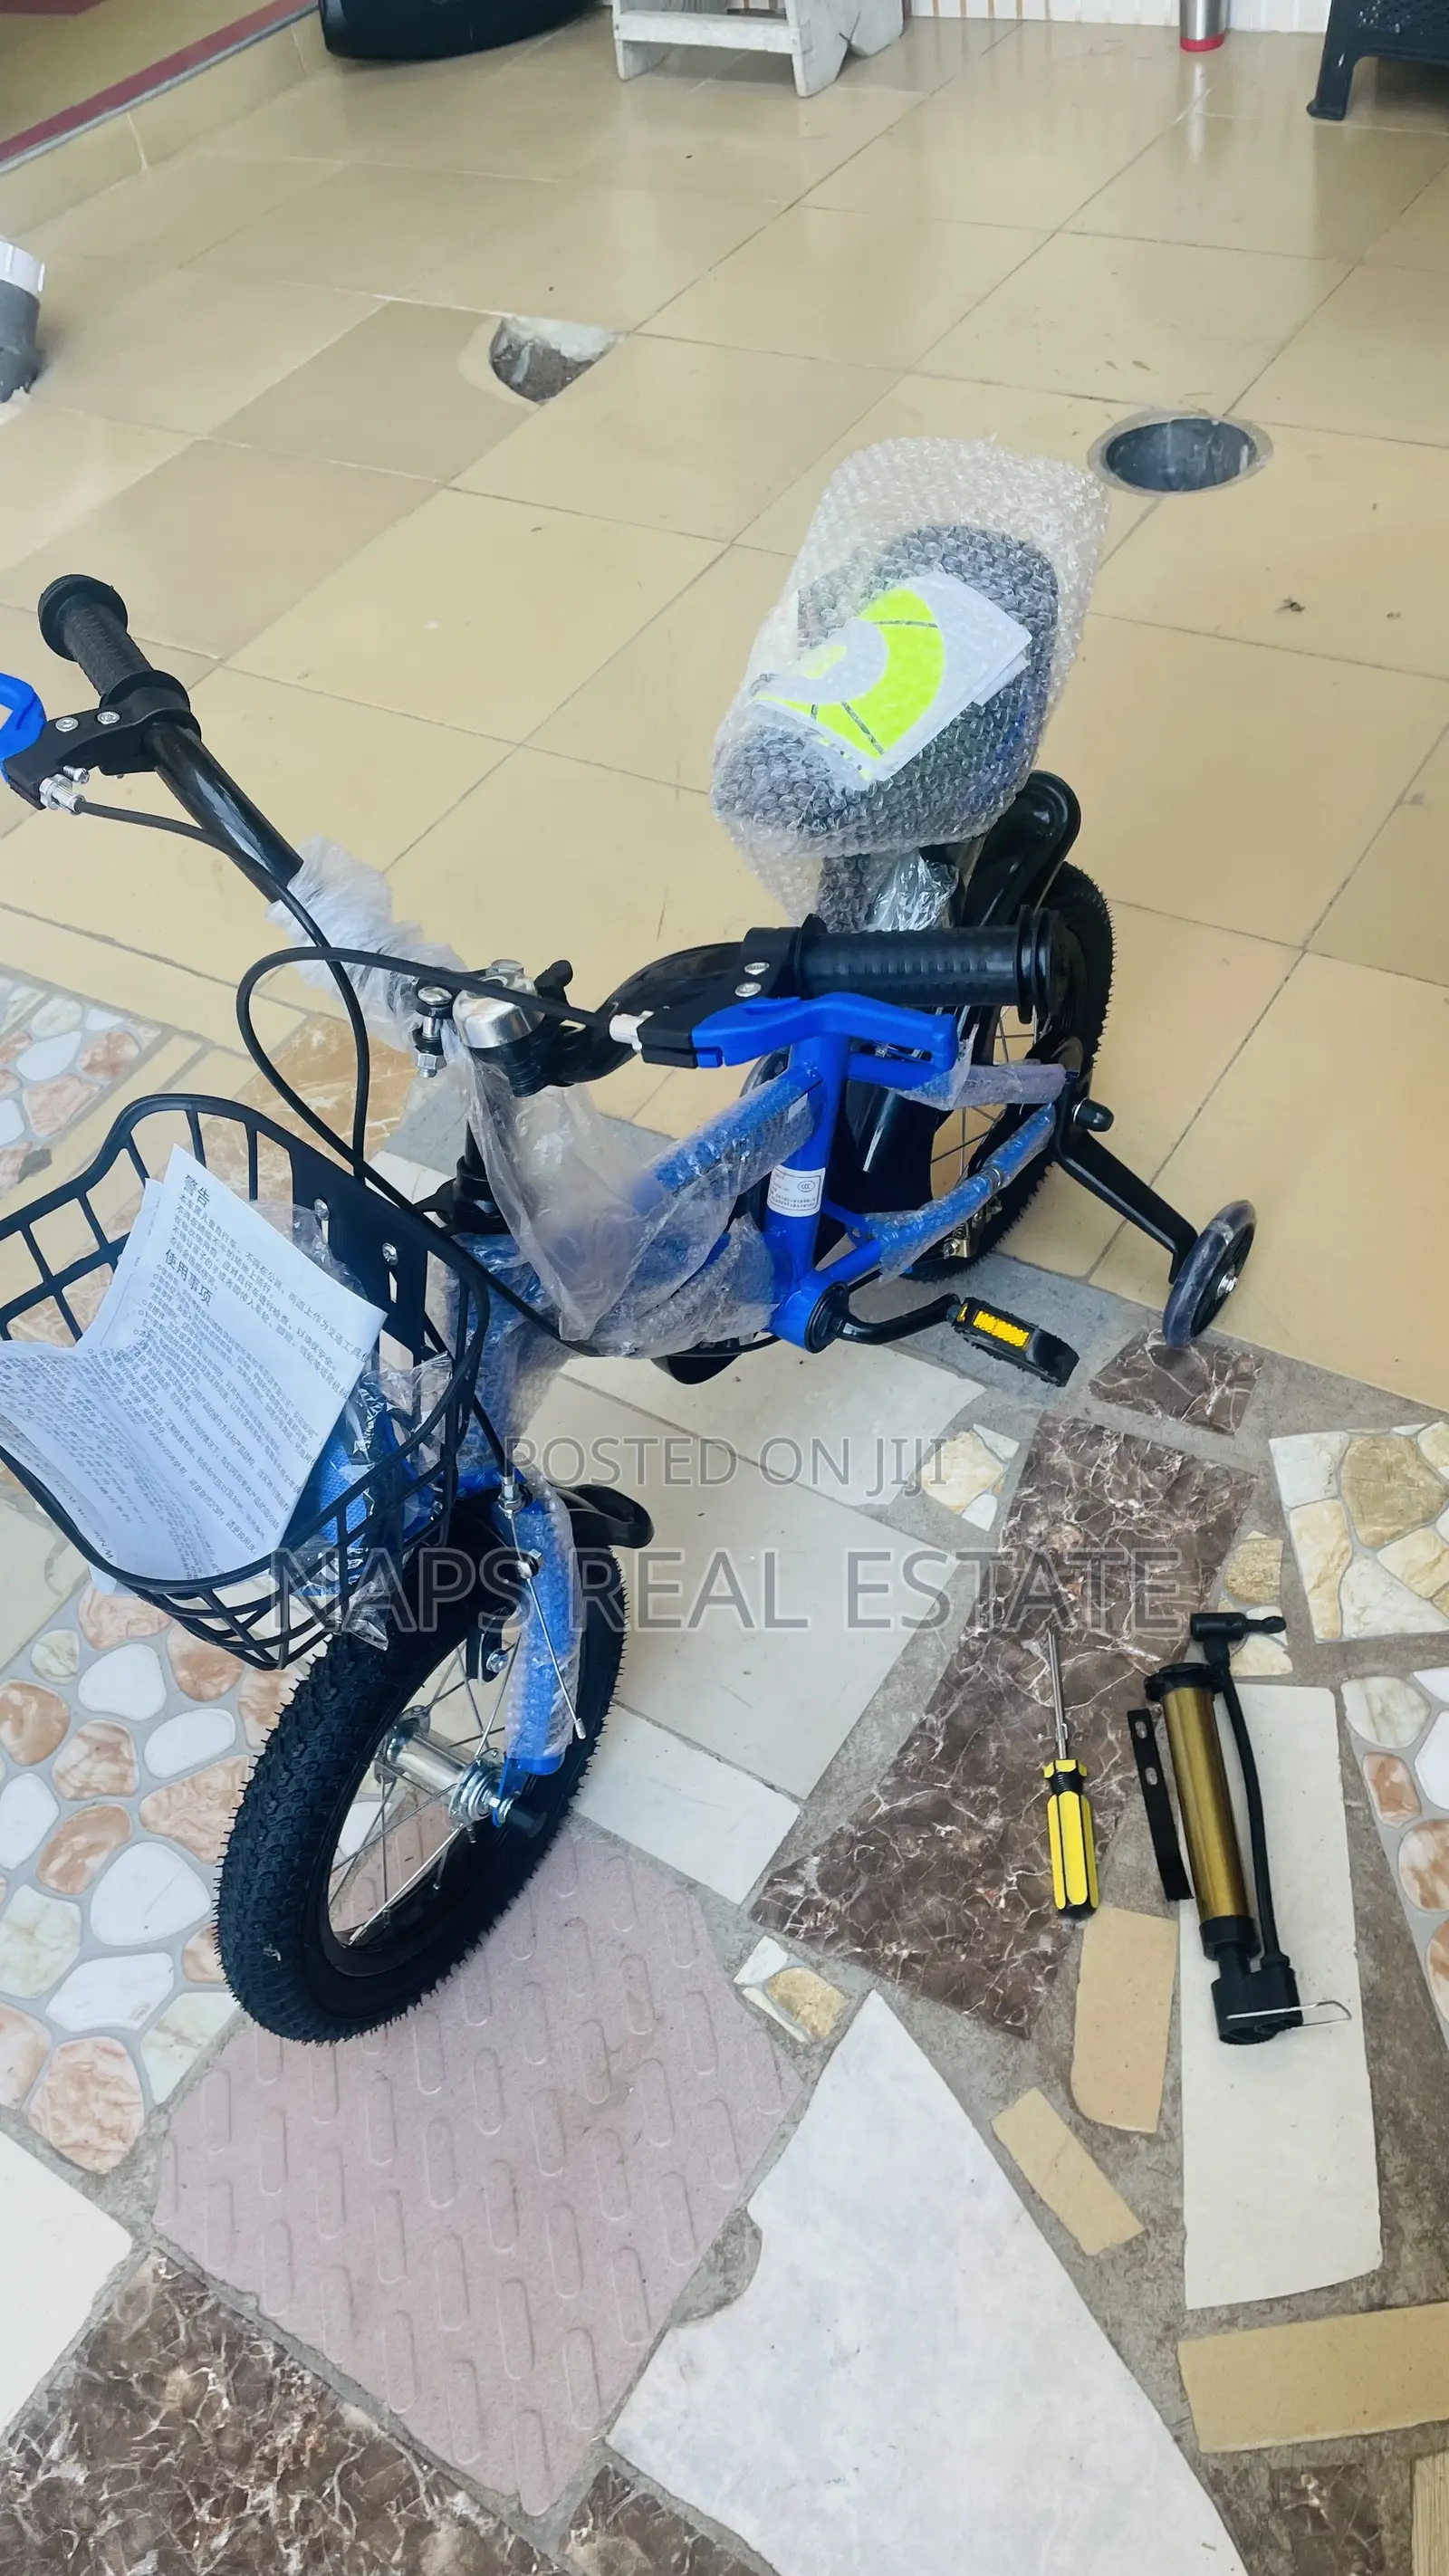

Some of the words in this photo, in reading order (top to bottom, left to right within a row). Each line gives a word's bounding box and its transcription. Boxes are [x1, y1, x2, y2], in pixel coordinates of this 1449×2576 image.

[184, 1174, 210, 1208] 警告
[165, 1249, 213, 1307] 使用事项
